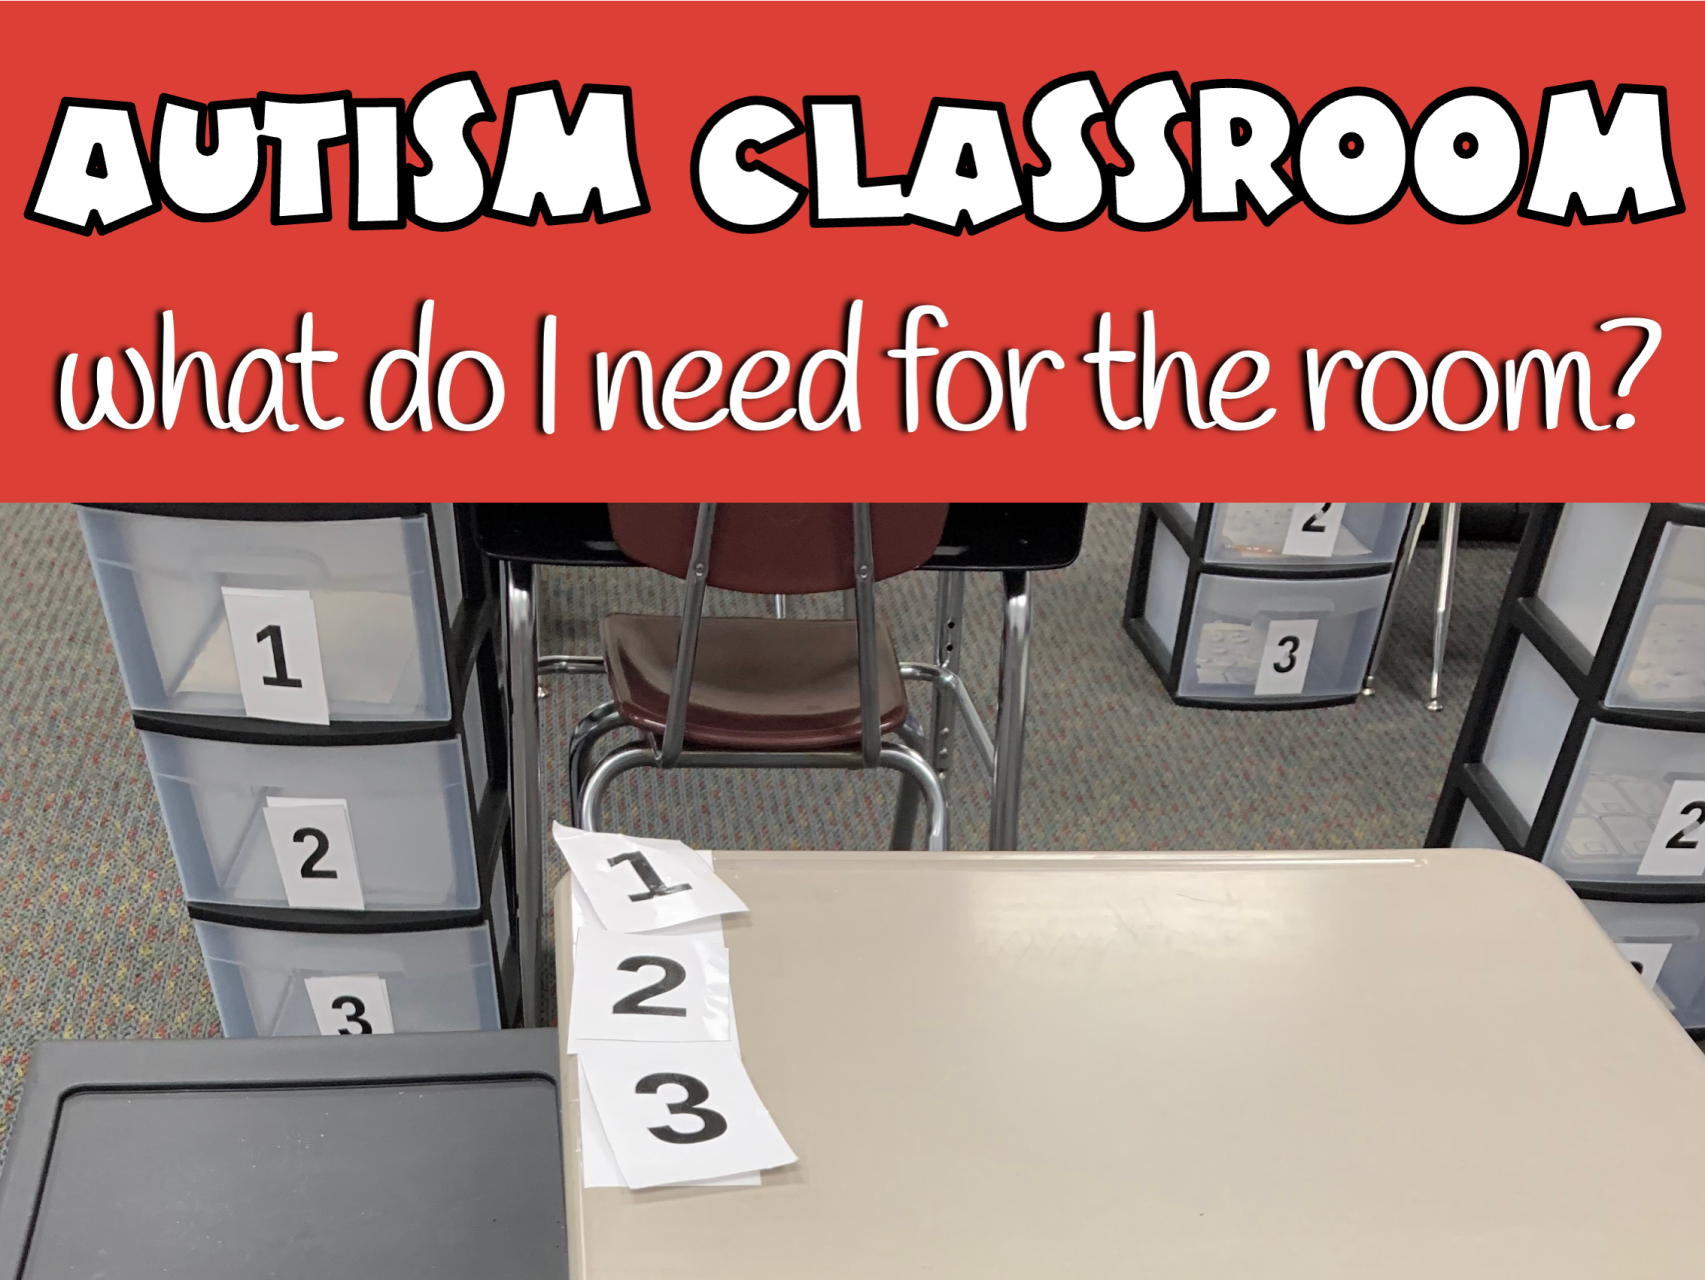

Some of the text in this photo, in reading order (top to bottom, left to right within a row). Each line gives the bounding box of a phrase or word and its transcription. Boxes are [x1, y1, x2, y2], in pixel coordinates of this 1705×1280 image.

[1302, 503, 1331, 532] 2
[257, 625, 302, 688] 1
[1273, 635, 1299, 674] 3
[1666, 800, 1705, 849] 2
[292, 827, 338, 879] 2
[607, 850, 693, 902] 1
[612, 955, 687, 1017] 2
[331, 995, 373, 1035] 3
[635, 1072, 728, 1144] 3
